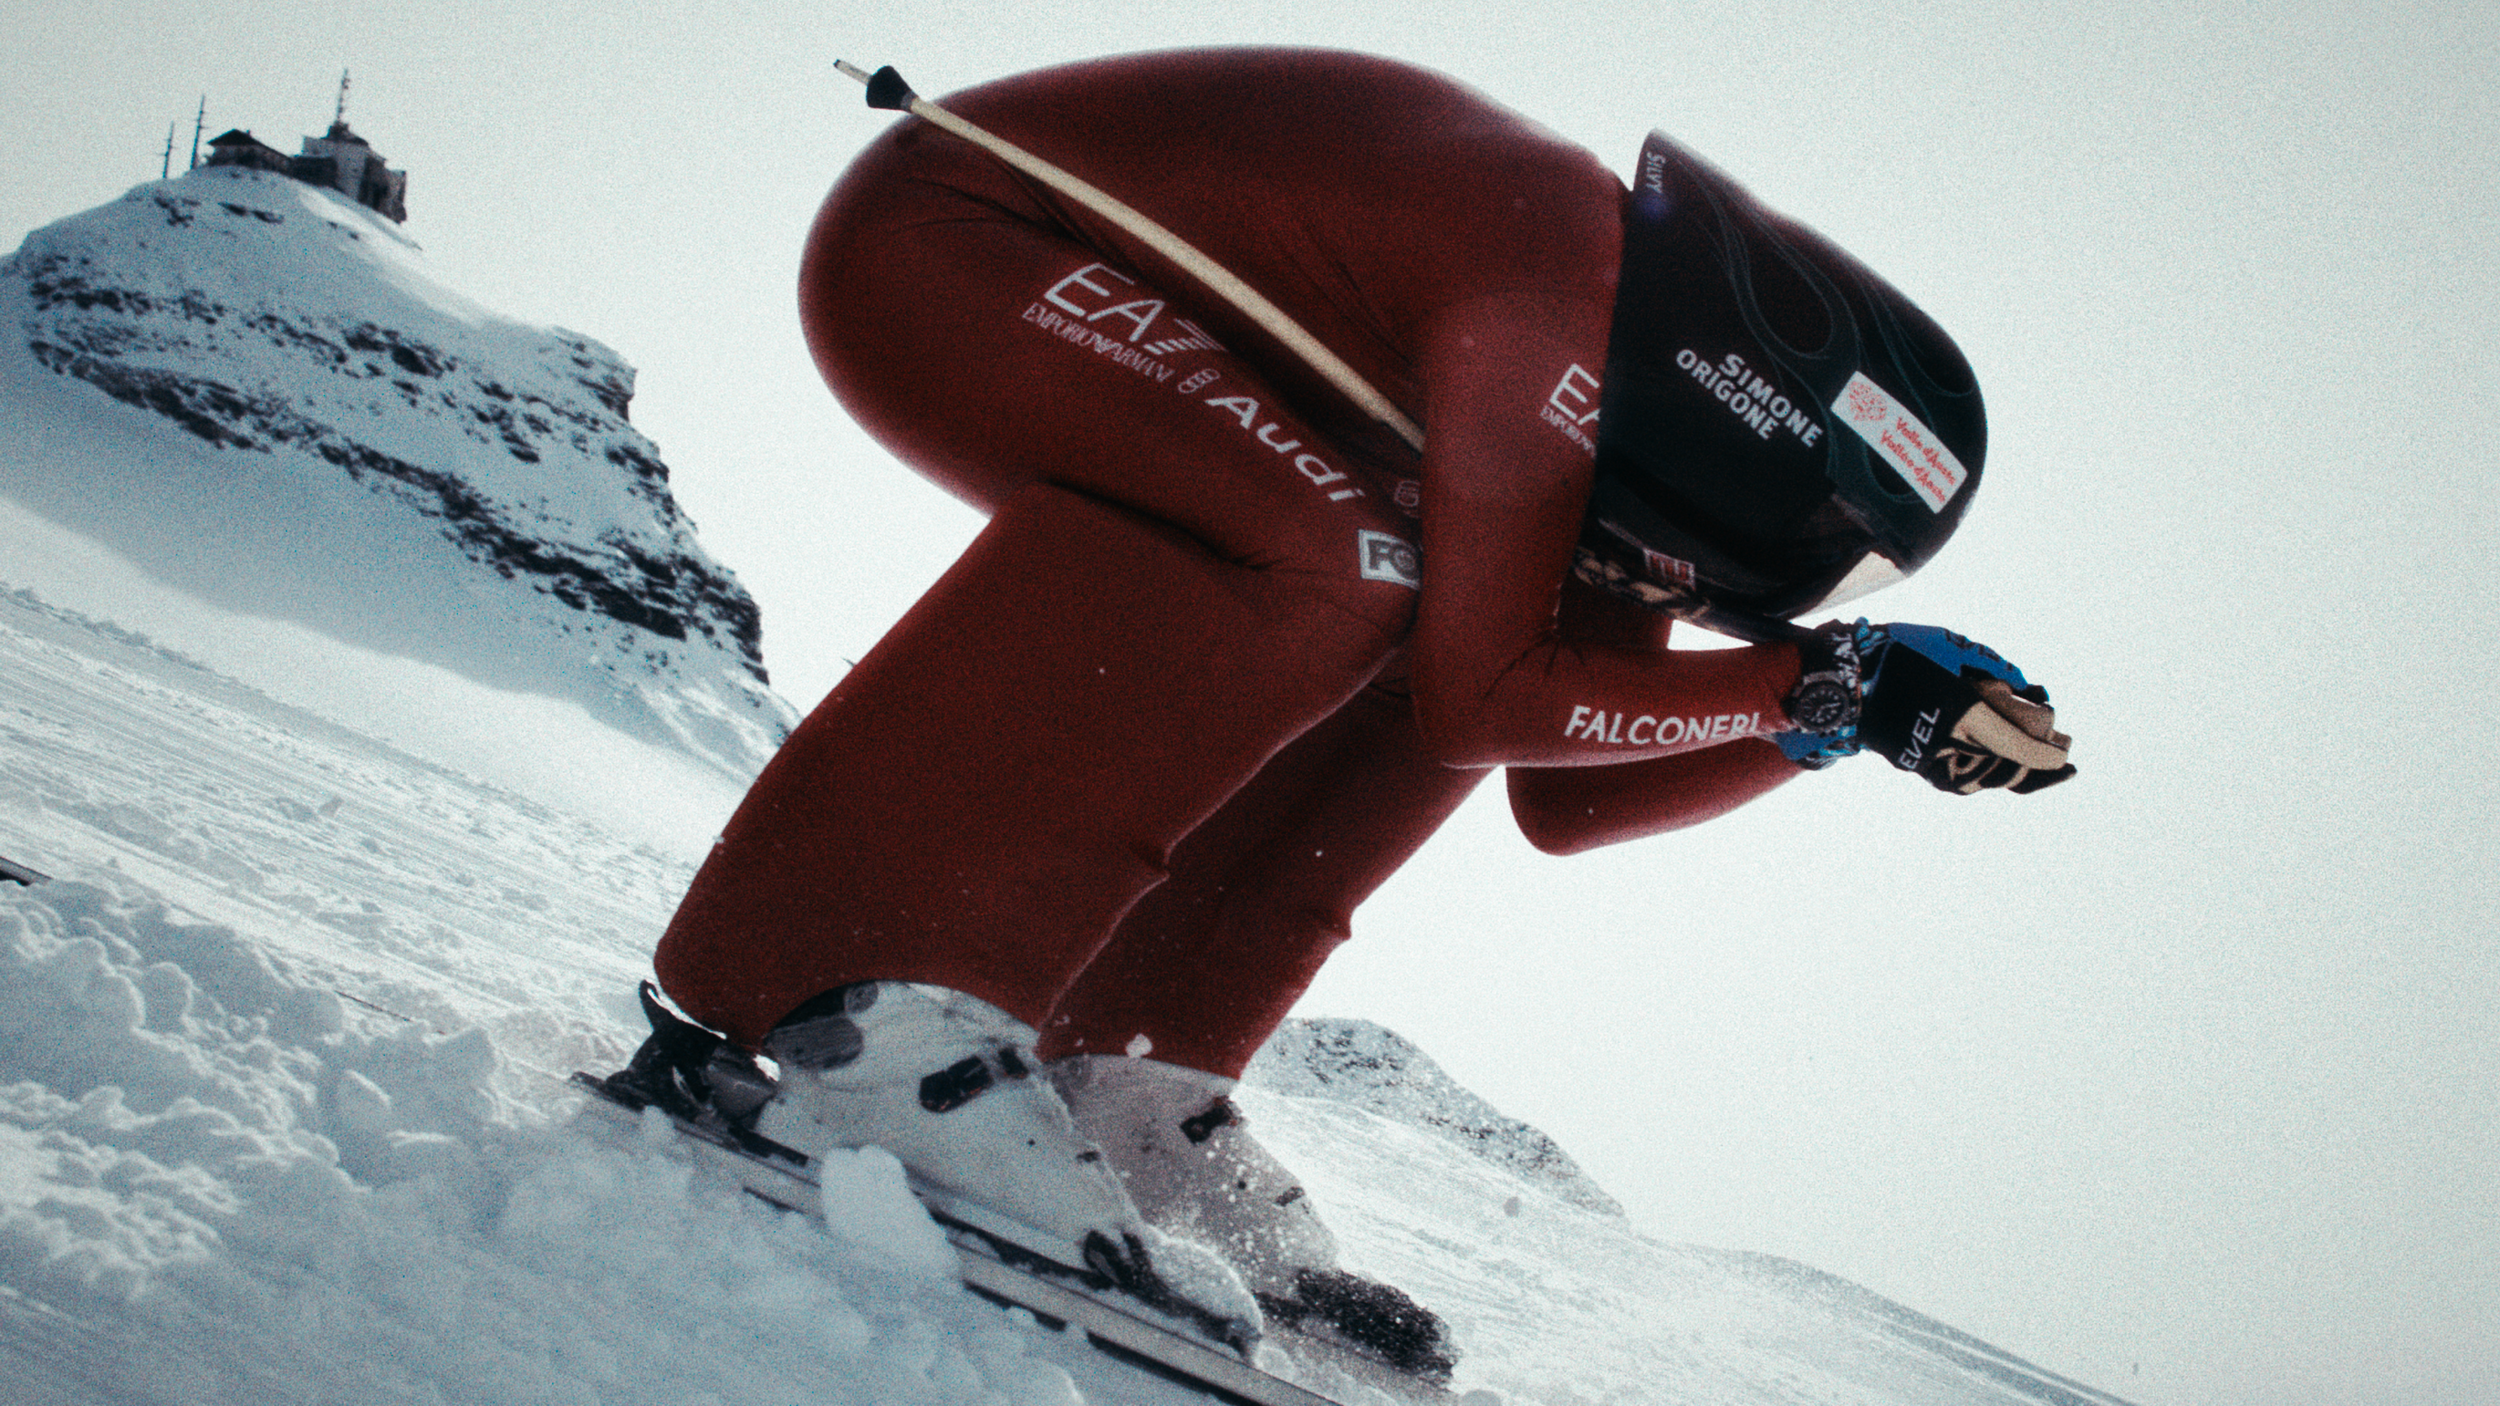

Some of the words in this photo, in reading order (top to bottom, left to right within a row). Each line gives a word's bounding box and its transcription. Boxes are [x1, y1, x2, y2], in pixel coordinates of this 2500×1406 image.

[1022, 302, 1097, 348] EMPORIO
[1676, 349, 1779, 440] ORIGONE
[1718, 353, 1824, 448] SIMONE
[1205, 396, 1365, 501] Audi
[1563, 704, 1760, 745] FALCONERI
[1899, 707, 1941, 770] EVEL
